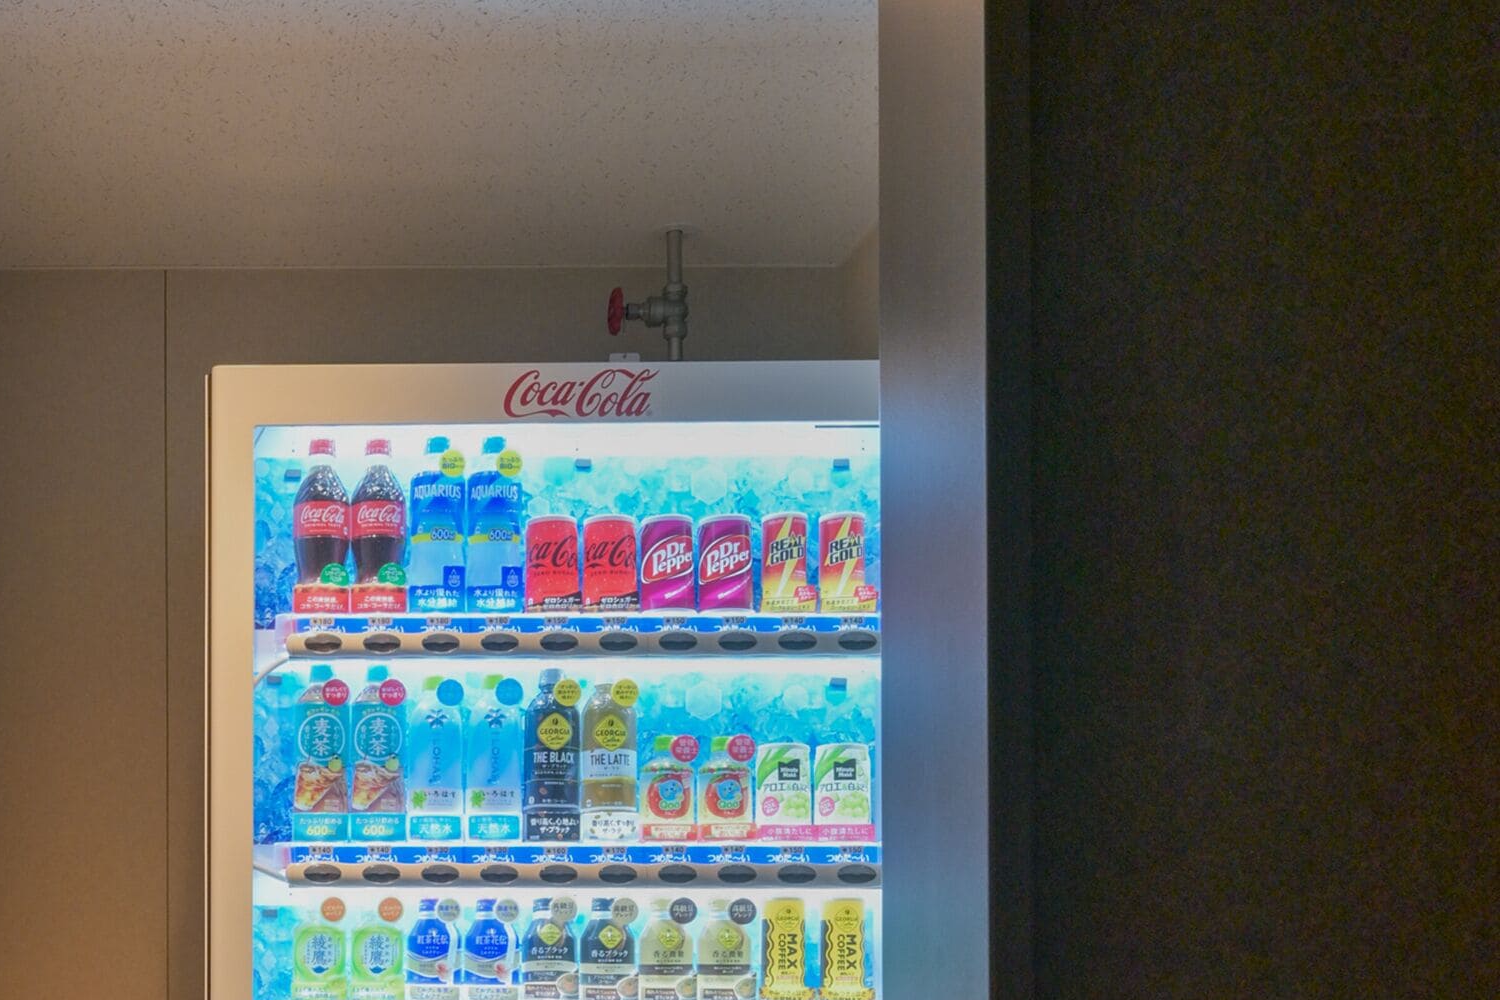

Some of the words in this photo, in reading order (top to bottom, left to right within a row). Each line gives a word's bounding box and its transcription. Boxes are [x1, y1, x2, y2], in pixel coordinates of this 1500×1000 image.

[503, 368, 660, 417] Coca-Cola
[414, 484, 462, 501] AQUARIUS
[471, 484, 518, 502] AQUARIUS
[667, 542, 687, 560] Dr
[719, 542, 740, 560] Dr
[770, 532, 805, 555] REAL
[829, 532, 864, 555] REAL
[706, 549, 750, 577] Pepper
[770, 546, 804, 566] GOLD
[829, 546, 864, 566] GOLD
[312, 717, 332, 756] 麦茶
[368, 717, 389, 756] 麦茶
[533, 752, 548, 764] THE
[549, 752, 575, 764] BLACK
[590, 753, 606, 766] THE
[608, 753, 631, 766] LATTE
[778, 933, 787, 970] COFFEE
[787, 933, 798, 969] MAX
[837, 934, 846, 971] COFFEE
[846, 934, 857, 970] MAX
